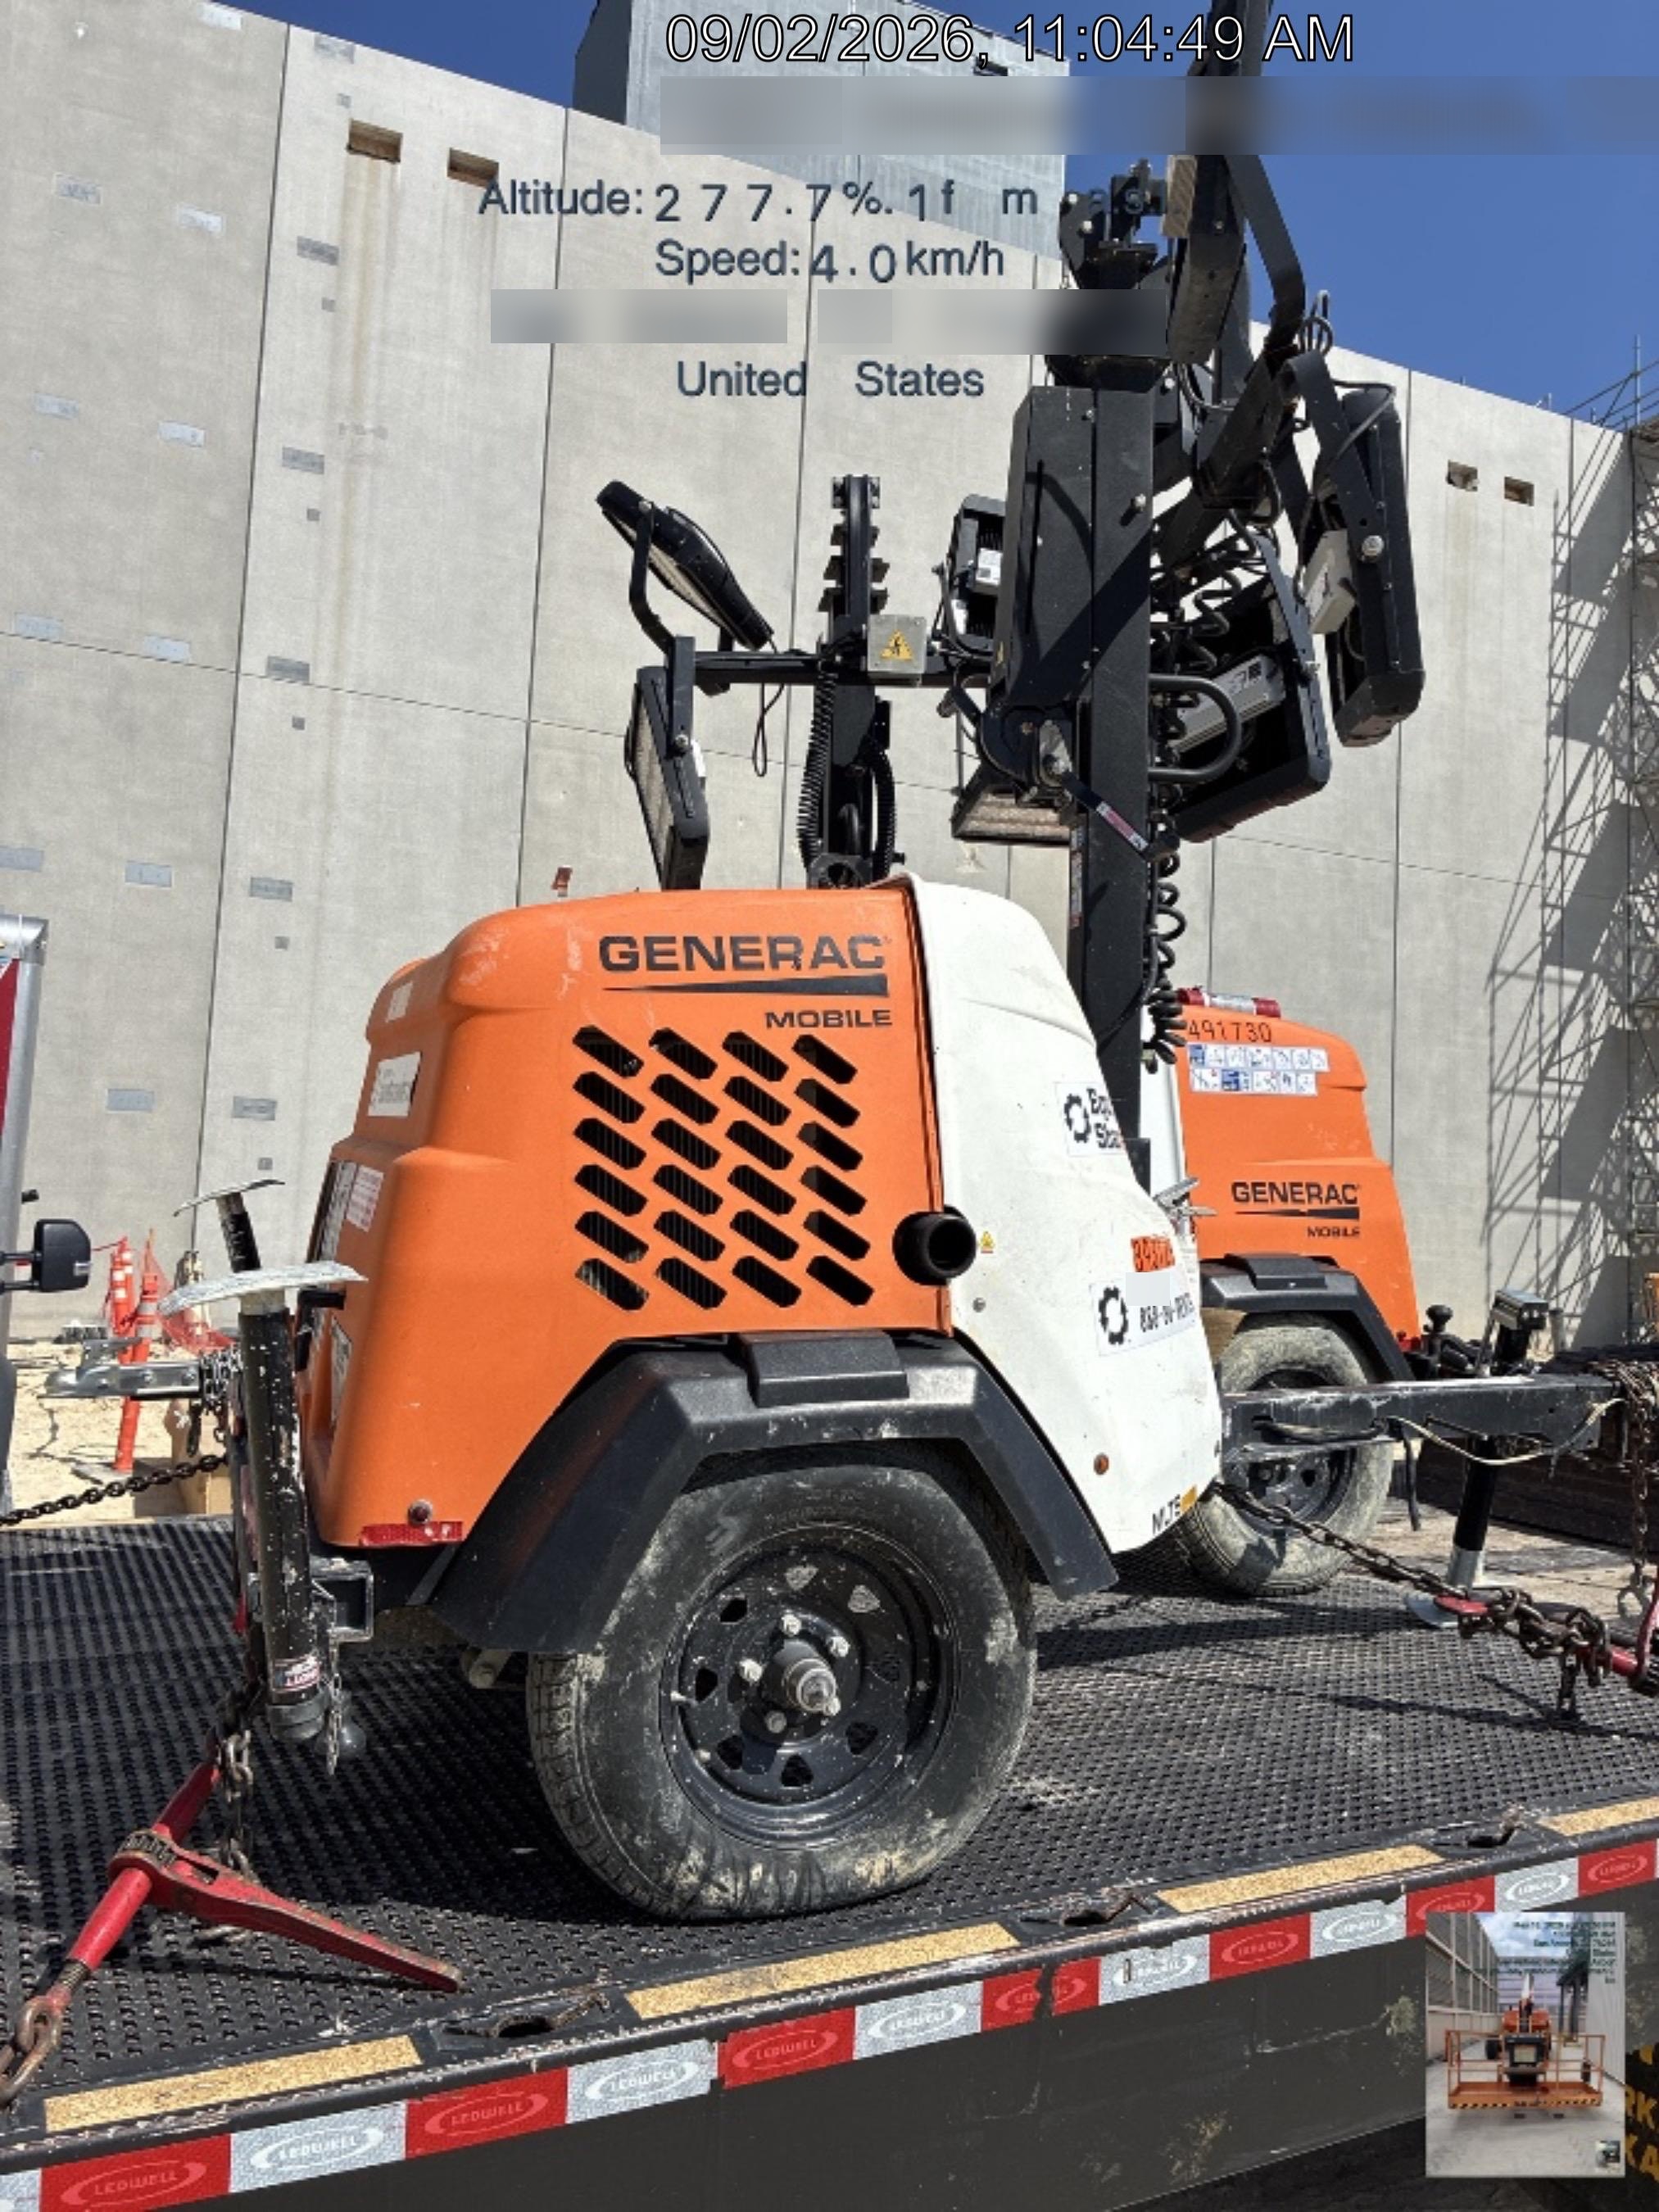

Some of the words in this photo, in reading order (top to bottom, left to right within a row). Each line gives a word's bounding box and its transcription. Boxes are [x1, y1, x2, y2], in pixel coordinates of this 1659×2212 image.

[598, 935, 887, 973] GENERAC
[764, 1009, 894, 1029] MOBILE
[1231, 1181, 1359, 1205] GENERAC
[1306, 1226, 1362, 1238] MOBILE
[451, 2102, 524, 2128] LEDWELL
[279, 2135, 358, 2160] LEDWELL
[93, 2170, 178, 2196] LEDWELL
